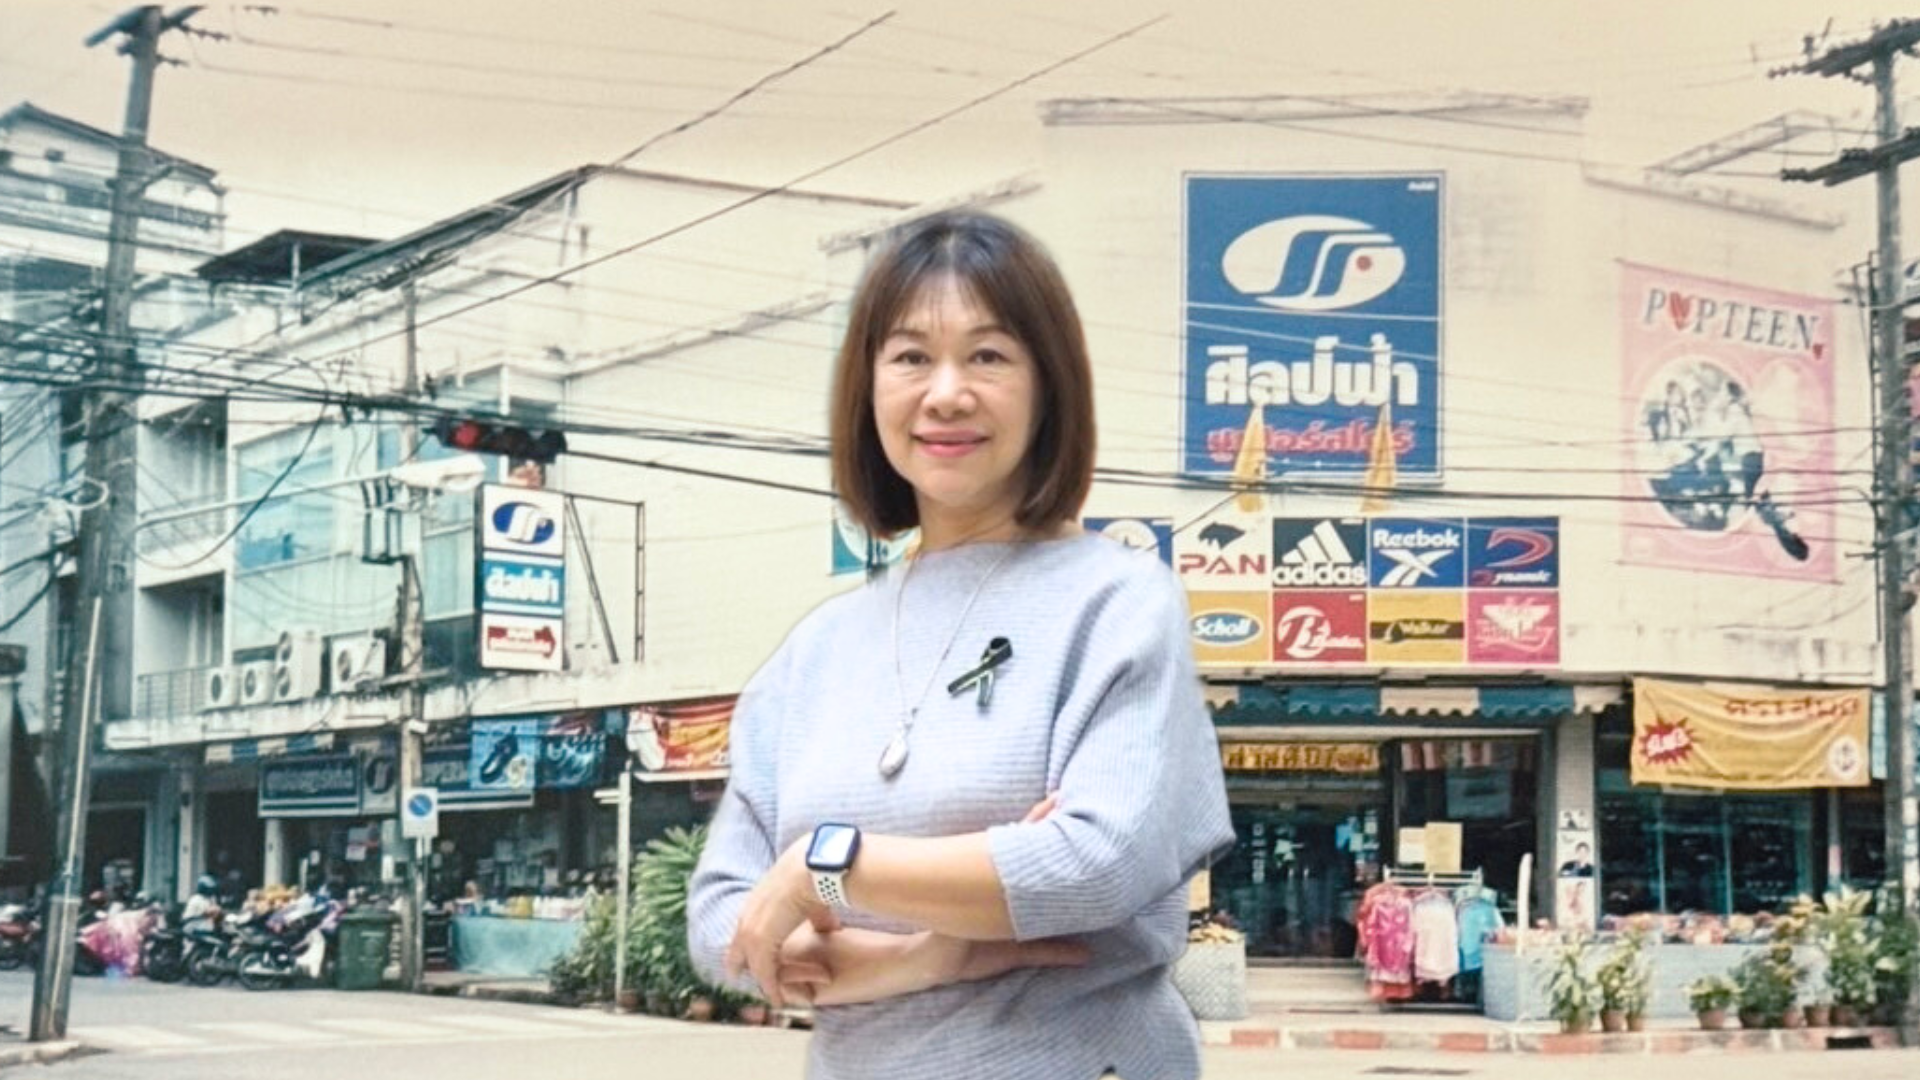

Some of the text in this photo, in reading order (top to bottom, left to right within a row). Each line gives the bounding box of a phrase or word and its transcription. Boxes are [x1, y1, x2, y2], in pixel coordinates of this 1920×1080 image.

[1206, 333, 1418, 406] ศิลป์ฟ้า
[1373, 529, 1460, 548] Reebok
[1180, 555, 1266, 575] PAN
[1274, 561, 1367, 586] adidas
[1193, 617, 1252, 637] Scholl
